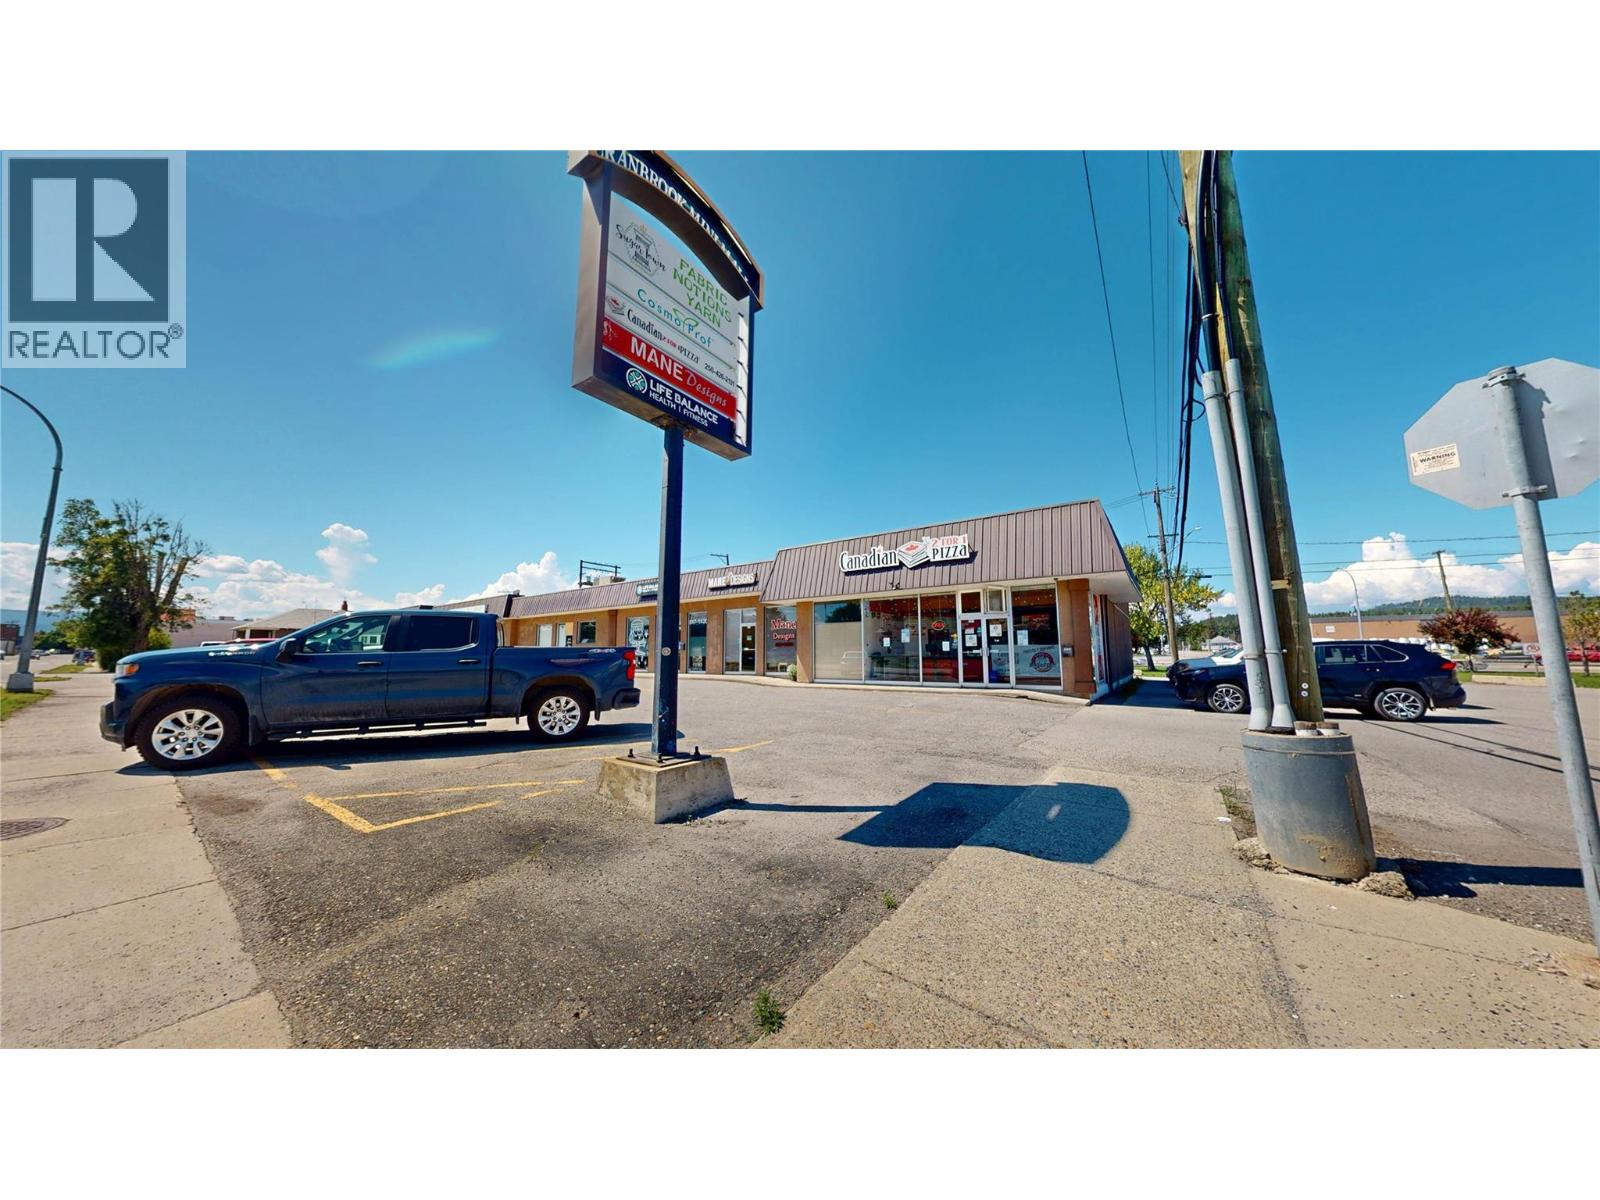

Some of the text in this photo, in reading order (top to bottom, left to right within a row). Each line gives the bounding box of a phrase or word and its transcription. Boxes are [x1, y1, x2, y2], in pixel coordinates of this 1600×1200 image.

[672, 267, 732, 323] NOTIONS
[679, 258, 728, 306] FABRIC
[627, 308, 662, 341] Canadian
[686, 292, 721, 328] YARN
[630, 337, 727, 407] MANE Designs
[649, 379, 719, 425] LIFE BALANCE
[649, 390, 708, 427] HEALTH FITNESS
[1419, 451, 1456, 463] WARNING
[840, 547, 898, 571] Canadian
[708, 576, 726, 588] MANE
